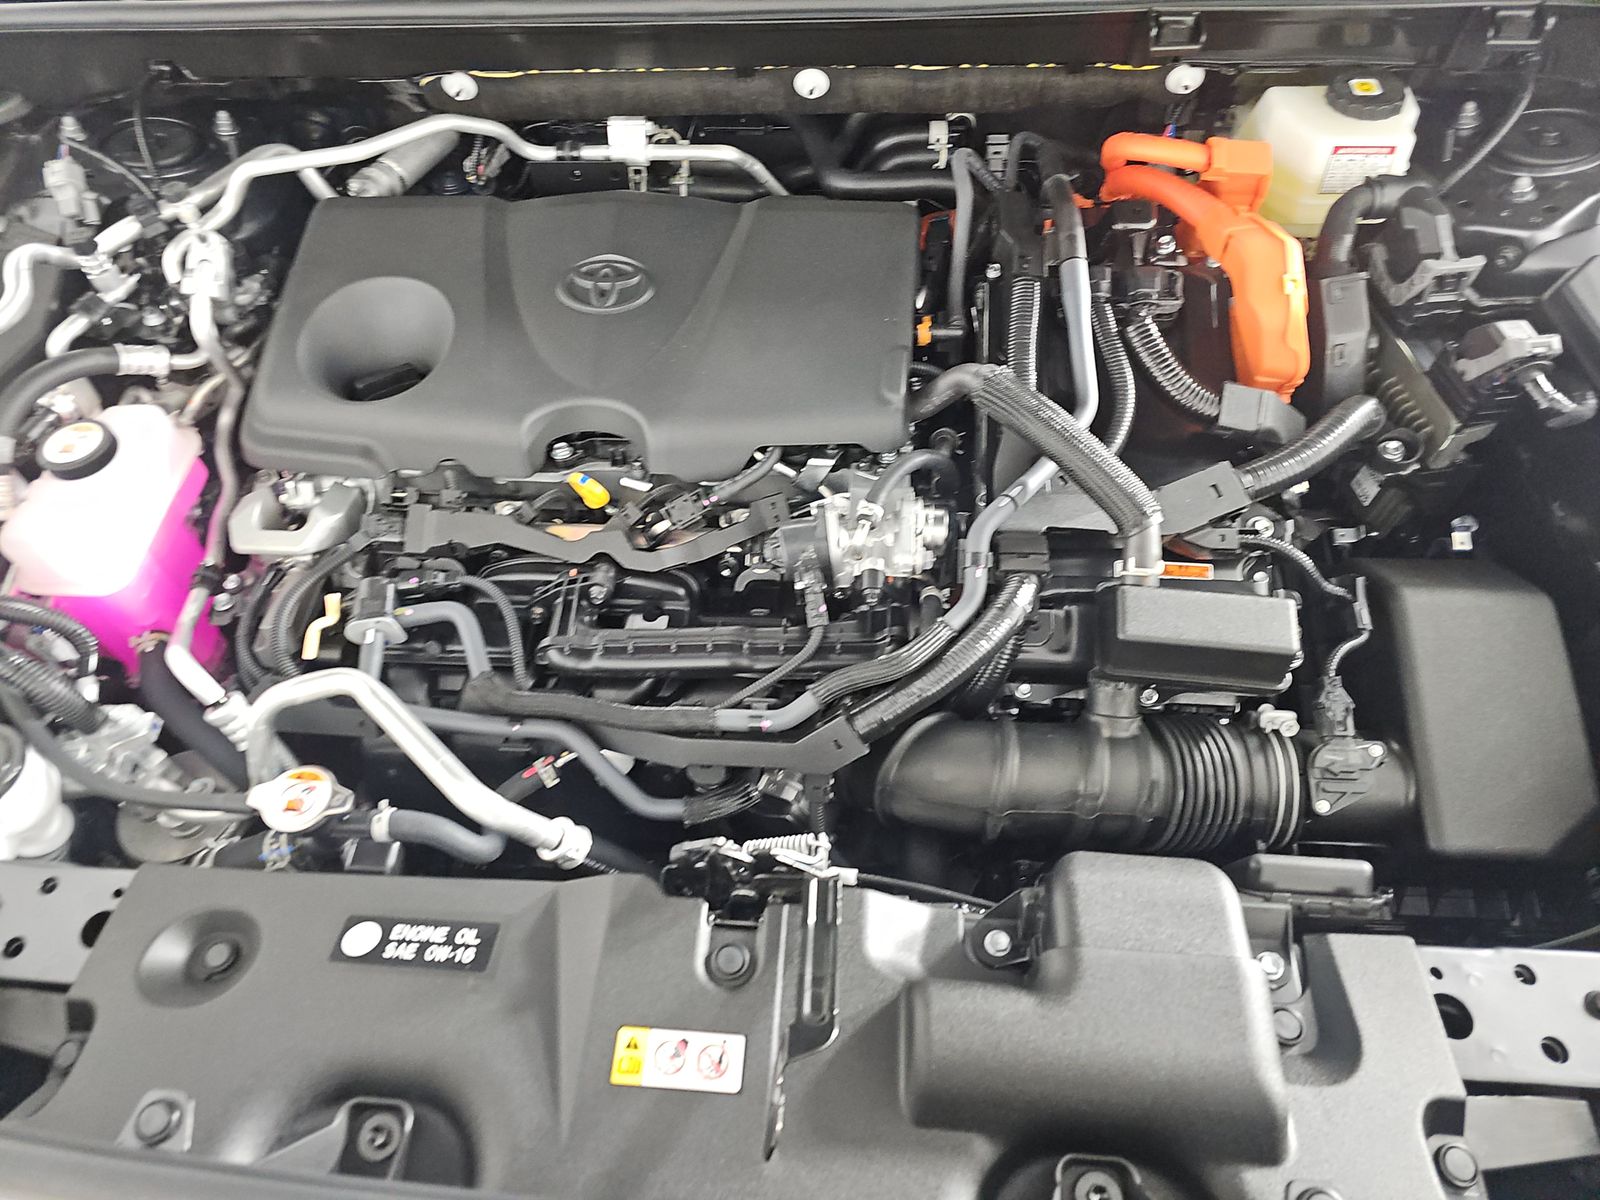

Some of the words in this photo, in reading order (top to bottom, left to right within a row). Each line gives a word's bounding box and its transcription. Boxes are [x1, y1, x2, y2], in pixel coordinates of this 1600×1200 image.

[389, 924, 450, 943] ENGINE
[454, 928, 481, 945] OIL
[382, 942, 420, 960] SAE
